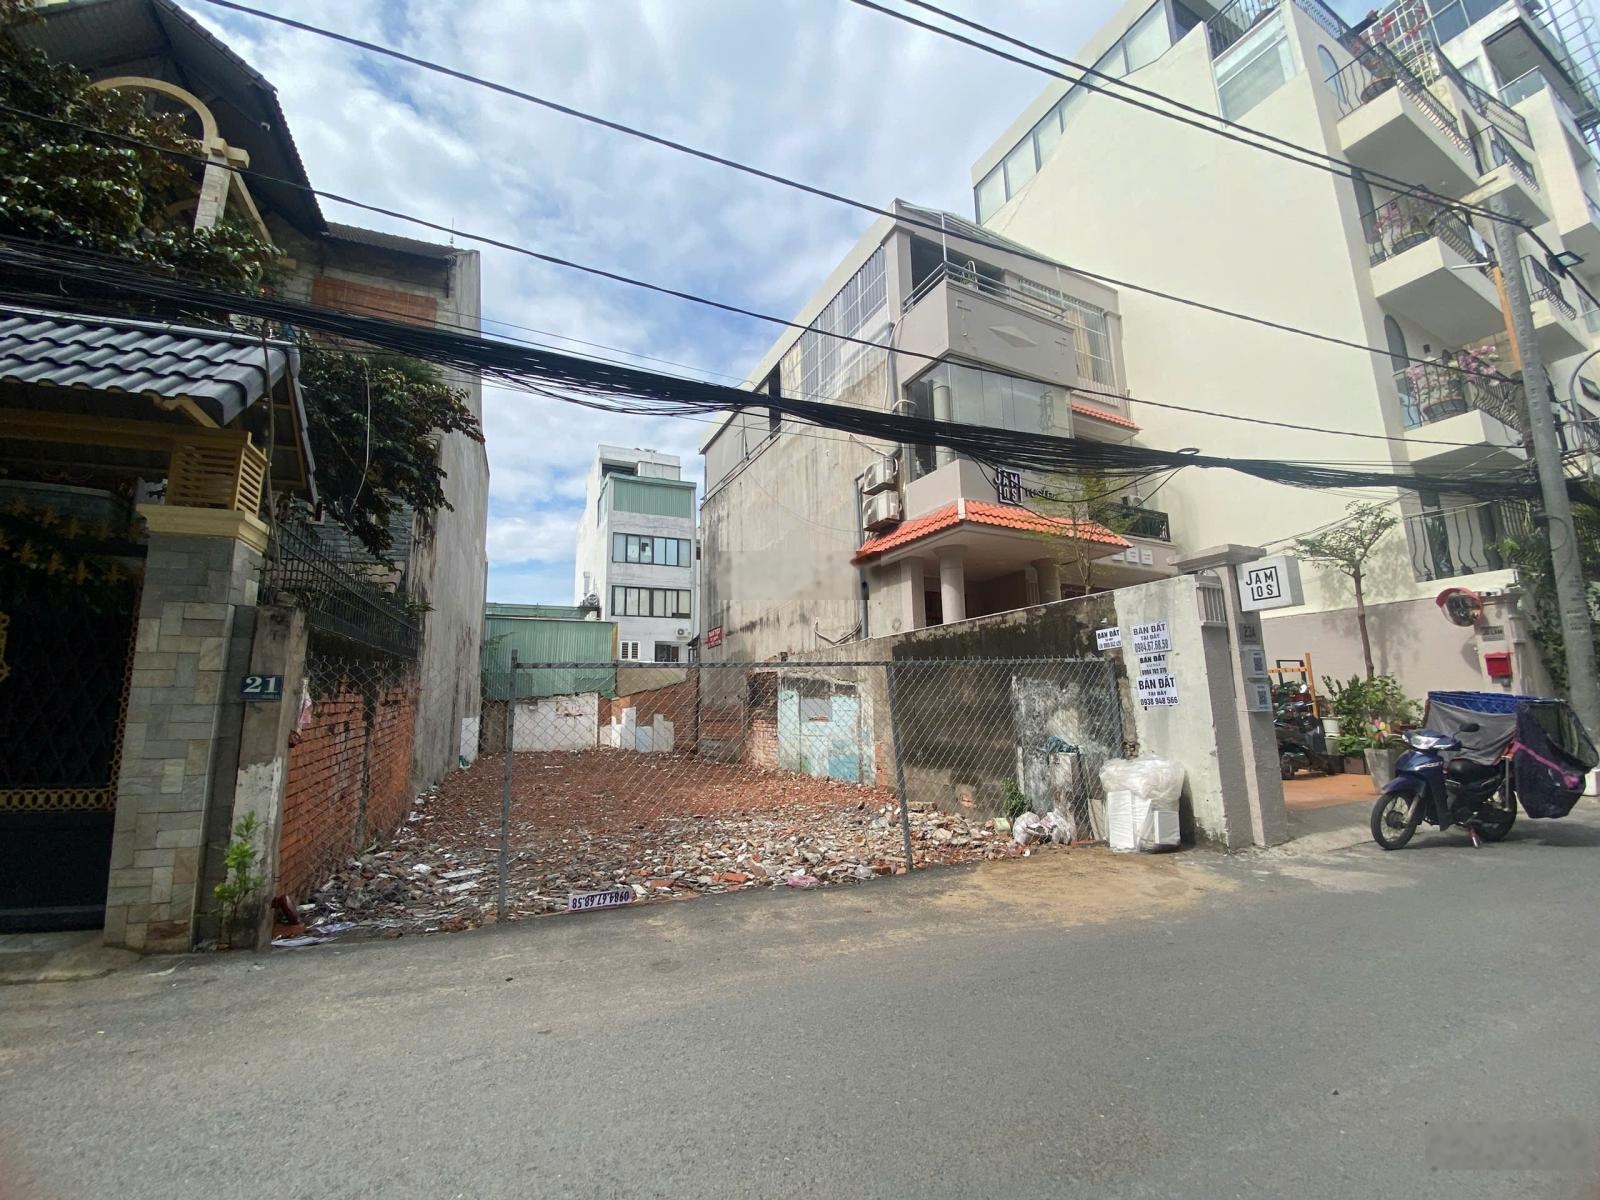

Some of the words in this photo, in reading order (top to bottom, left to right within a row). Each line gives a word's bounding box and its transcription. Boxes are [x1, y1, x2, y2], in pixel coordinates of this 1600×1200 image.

[1246, 570, 1274, 586] JAM
[243, 676, 278, 693] 21
[1138, 678, 1156, 690] BÁN
